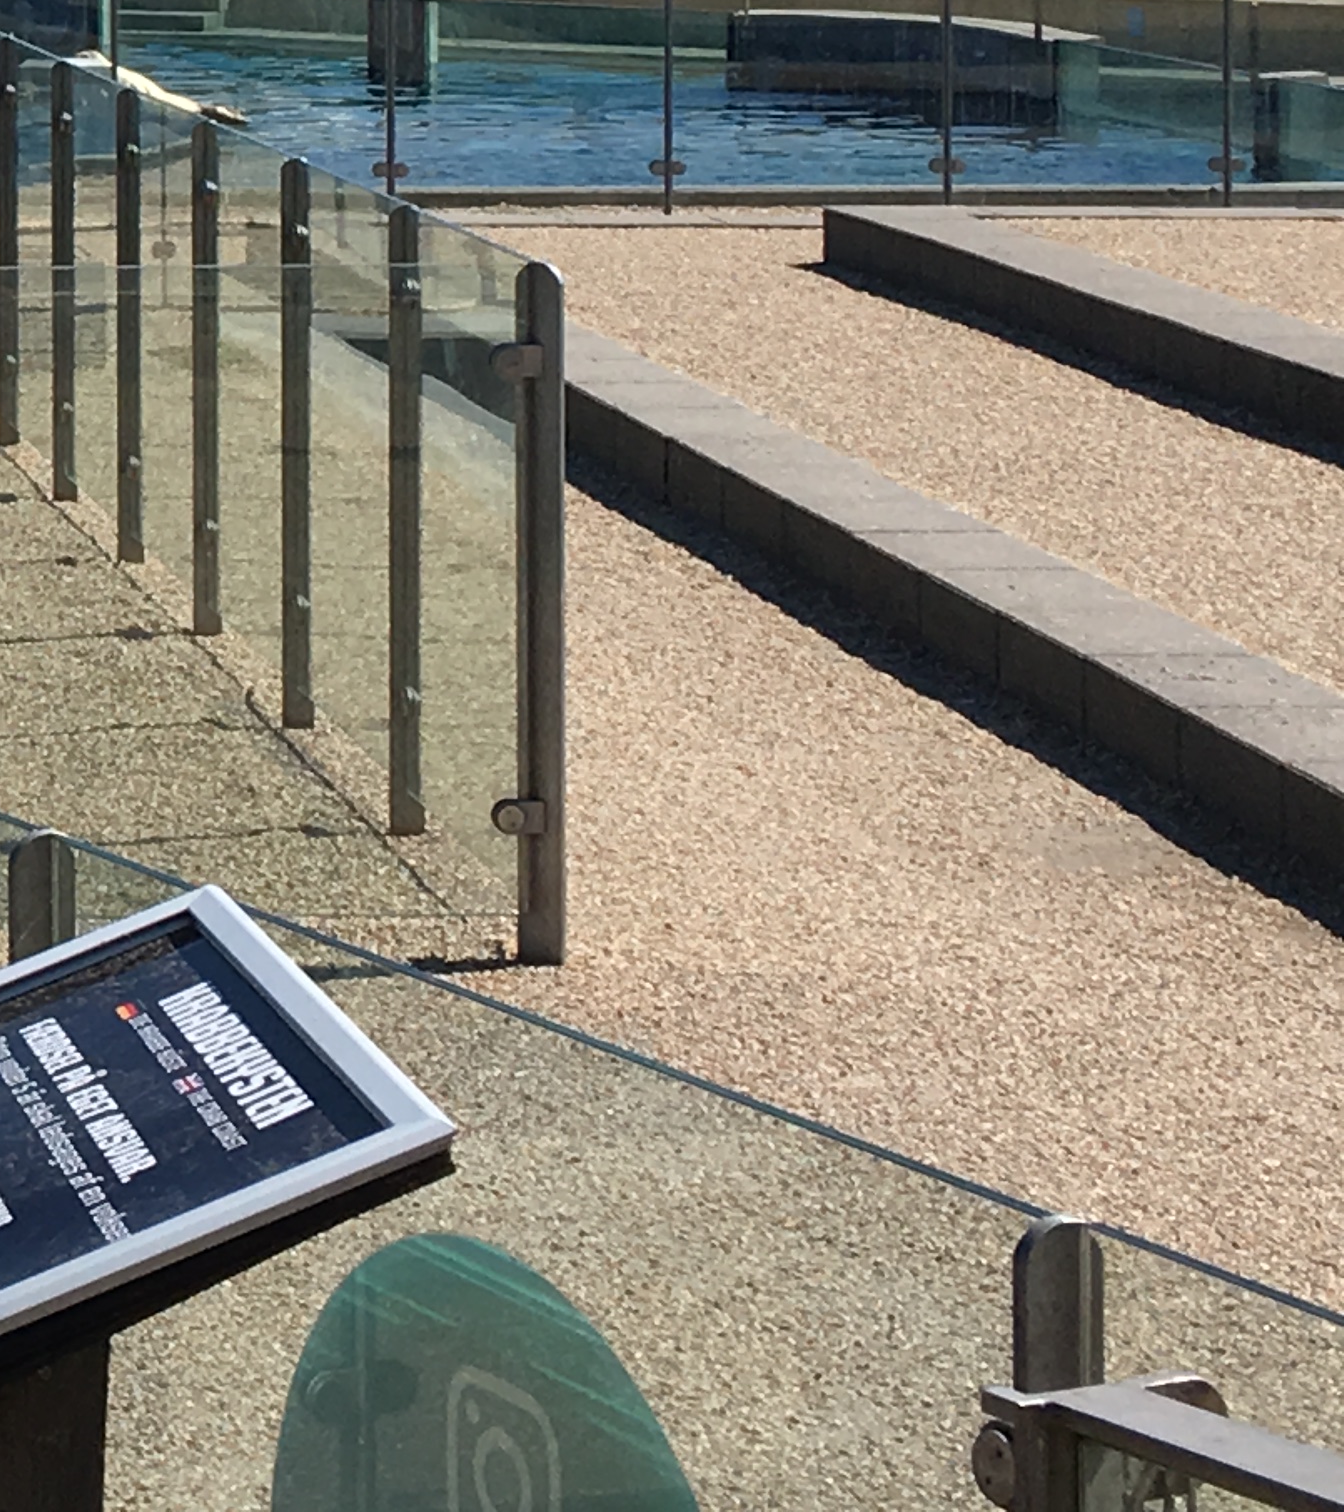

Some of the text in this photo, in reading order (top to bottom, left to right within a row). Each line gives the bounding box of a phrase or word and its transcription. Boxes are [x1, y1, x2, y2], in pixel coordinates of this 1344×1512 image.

[51, 1063, 108, 1094] PÅ
[158, 981, 315, 1131] KRABBEKYSTEN
[66, 1083, 119, 1122] EGET
[84, 1112, 158, 1185] ANSVAR.
